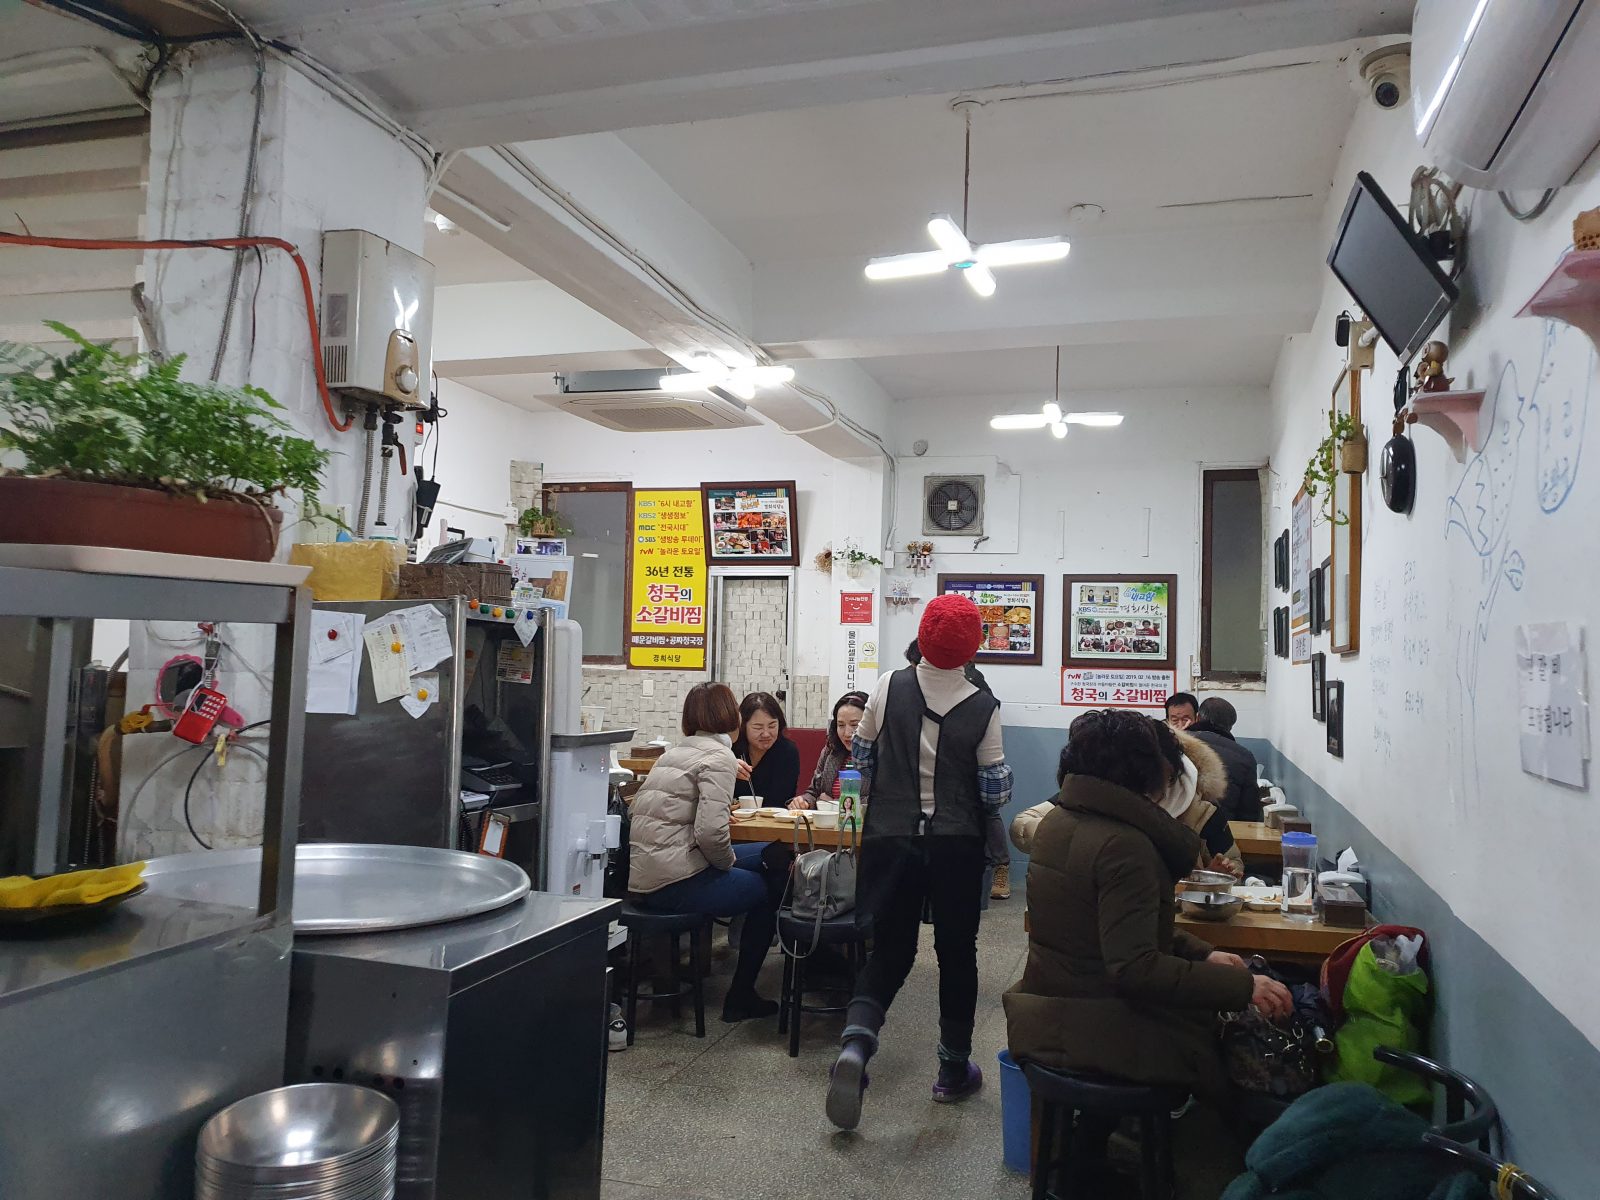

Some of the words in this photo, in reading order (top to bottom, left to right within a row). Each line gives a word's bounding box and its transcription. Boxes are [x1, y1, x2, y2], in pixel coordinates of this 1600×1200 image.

[645, 566, 669, 578] 36년
[673, 566, 695, 578] 전통
[648, 584, 692, 602] 청국의
[636, 606, 702, 625] 소갈비찜
[1120, 603, 1160, 616] 경희식당
[653, 654, 681, 663] 경희식당
[1071, 687, 1108, 702] 청국의
[1112, 688, 1167, 702] 소갈비찜
